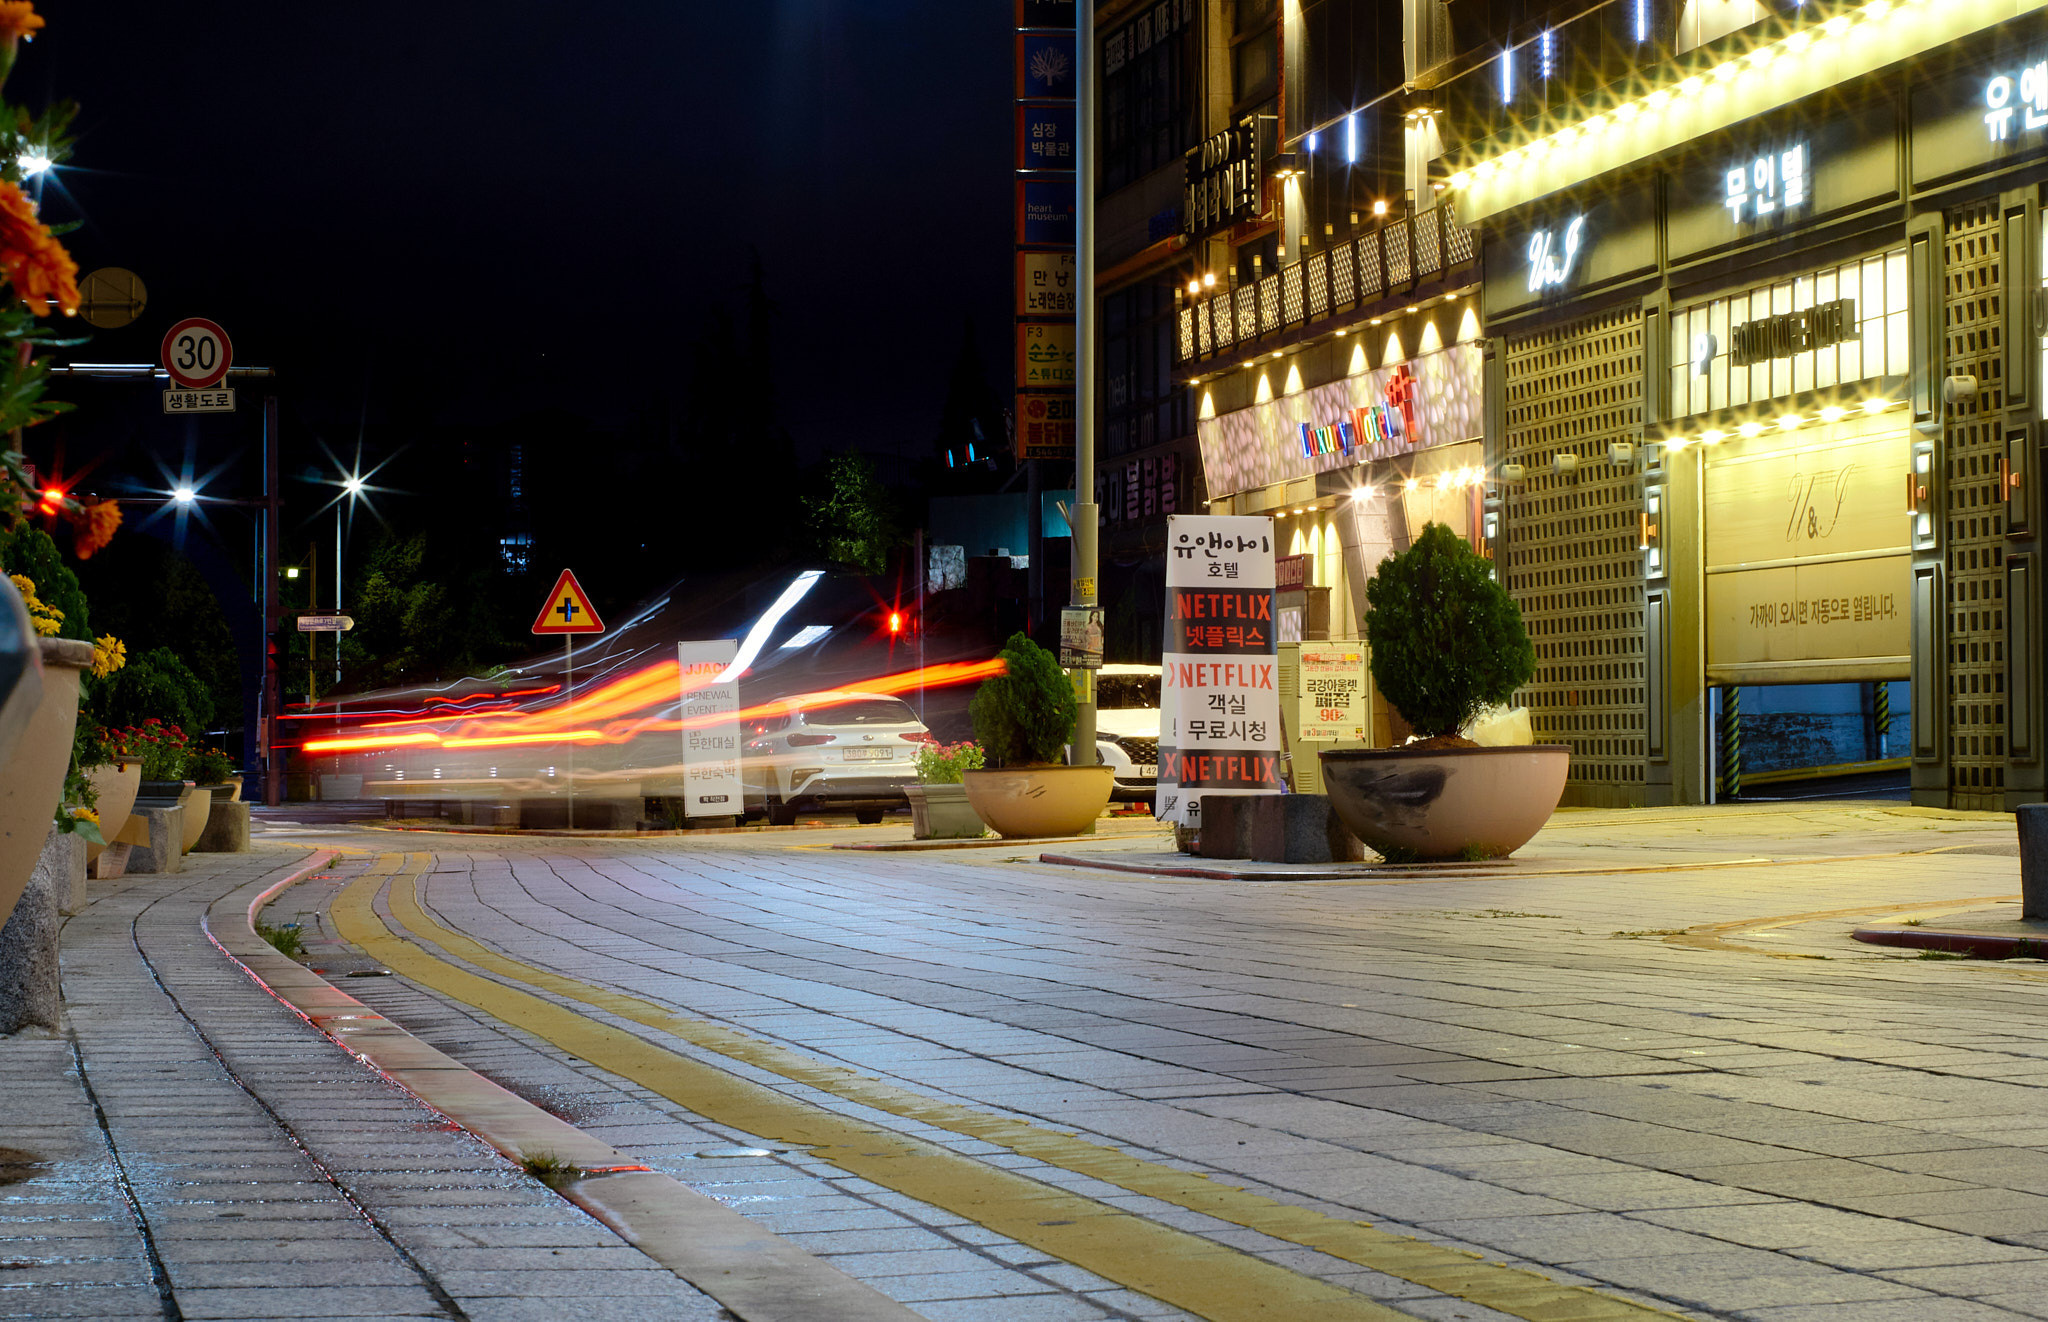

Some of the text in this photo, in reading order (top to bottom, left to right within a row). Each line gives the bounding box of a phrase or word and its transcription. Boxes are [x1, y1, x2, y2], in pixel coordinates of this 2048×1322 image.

[1031, 122, 1057, 138] 심장
[1031, 141, 1070, 157] 박물관
[1726, 144, 1803, 224] 무인텔
[1027, 203, 1052, 213] heart
[1027, 212, 1068, 222] museum
[1028, 292, 1075, 311] 노래연습장
[1027, 327, 1043, 338] F3
[177, 335, 215, 370] 30
[1028, 369, 1075, 381] 스튜디오
[169, 393, 230, 409] 생활도로
[1297, 421, 1350, 459] Luxury
[1348, 400, 1394, 446] Motel
[1173, 531, 1270, 559] 유앤아이
[1207, 562, 1239, 579] 호텔
[1177, 593, 1271, 621] NETFLIX
[1750, 593, 1898, 629] 가까이 오시면 자동으로 열립니다.
[1186, 626, 1265, 648] 넷플릭스
[1179, 663, 1273, 690] NETFLIX
[1307, 679, 1357, 692] 금강아울렛
[686, 690, 733, 700] RENEWAL
[687, 704, 717, 715] EVENT
[1208, 694, 1246, 715] 객실
[1188, 720, 1266, 741] 무료시청
[689, 736, 735, 751] 무한대실
[690, 765, 737, 780] 무한숙박
[1181, 755, 1276, 784] NETFLIX
